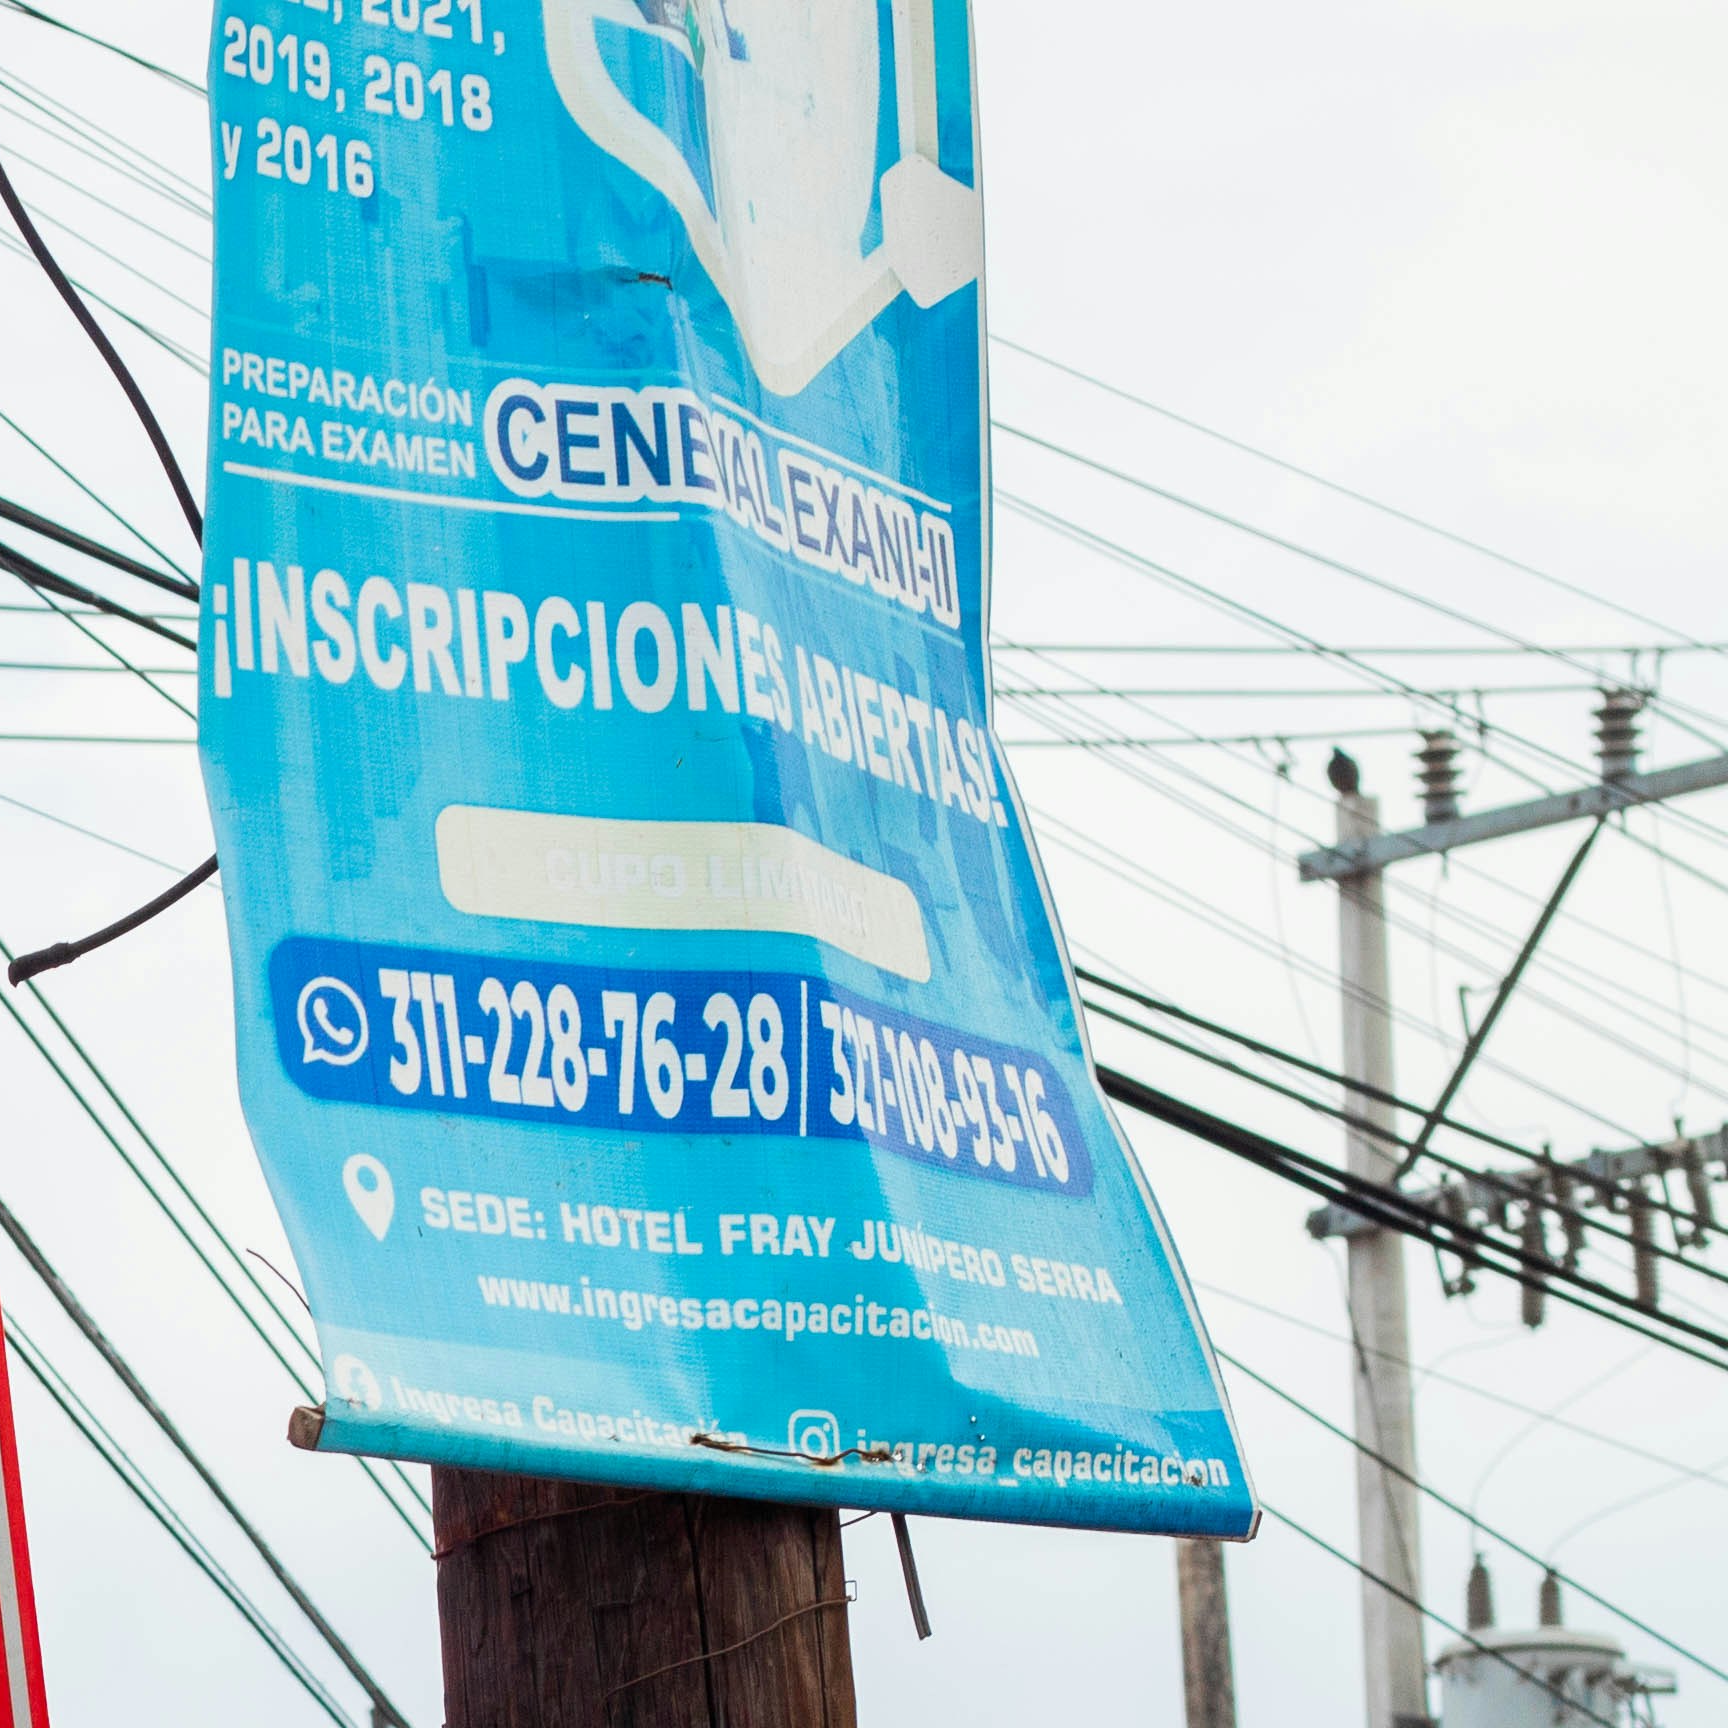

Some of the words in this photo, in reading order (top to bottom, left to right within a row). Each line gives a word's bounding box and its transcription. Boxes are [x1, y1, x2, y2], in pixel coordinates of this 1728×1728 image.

[223, 16, 345, 113] 2019,
[363, 55, 493, 132] 2018
[221, 121, 242, 181] y
[256, 117, 374, 198] 2016
[223, 347, 474, 427] PREPARACIÓN
[223, 402, 316, 457] PARA
[321, 420, 477, 479] EXAMEN
[494, 391, 785, 538] CENEVAL
[213, 556, 793, 733] ¡INSCRIPCIONES
[794, 644, 1009, 829] ABIERTAS!
[378, 968, 789, 1121] 311-228-76-28
[820, 1000, 1069, 1184] 327-108-93-16
[420, 1187, 547, 1240] SEDE:
[559, 1202, 703, 1255] HOTEL
[718, 1213, 836, 1258] FRAY
[850, 1220, 1007, 1288] JUNÍPERO
[1011, 1253, 1124, 1305] SERRA
[477, 1275, 1040, 1358] www.ingresacapacitacion.com
[391, 1375, 523, 1430] Ingresa
